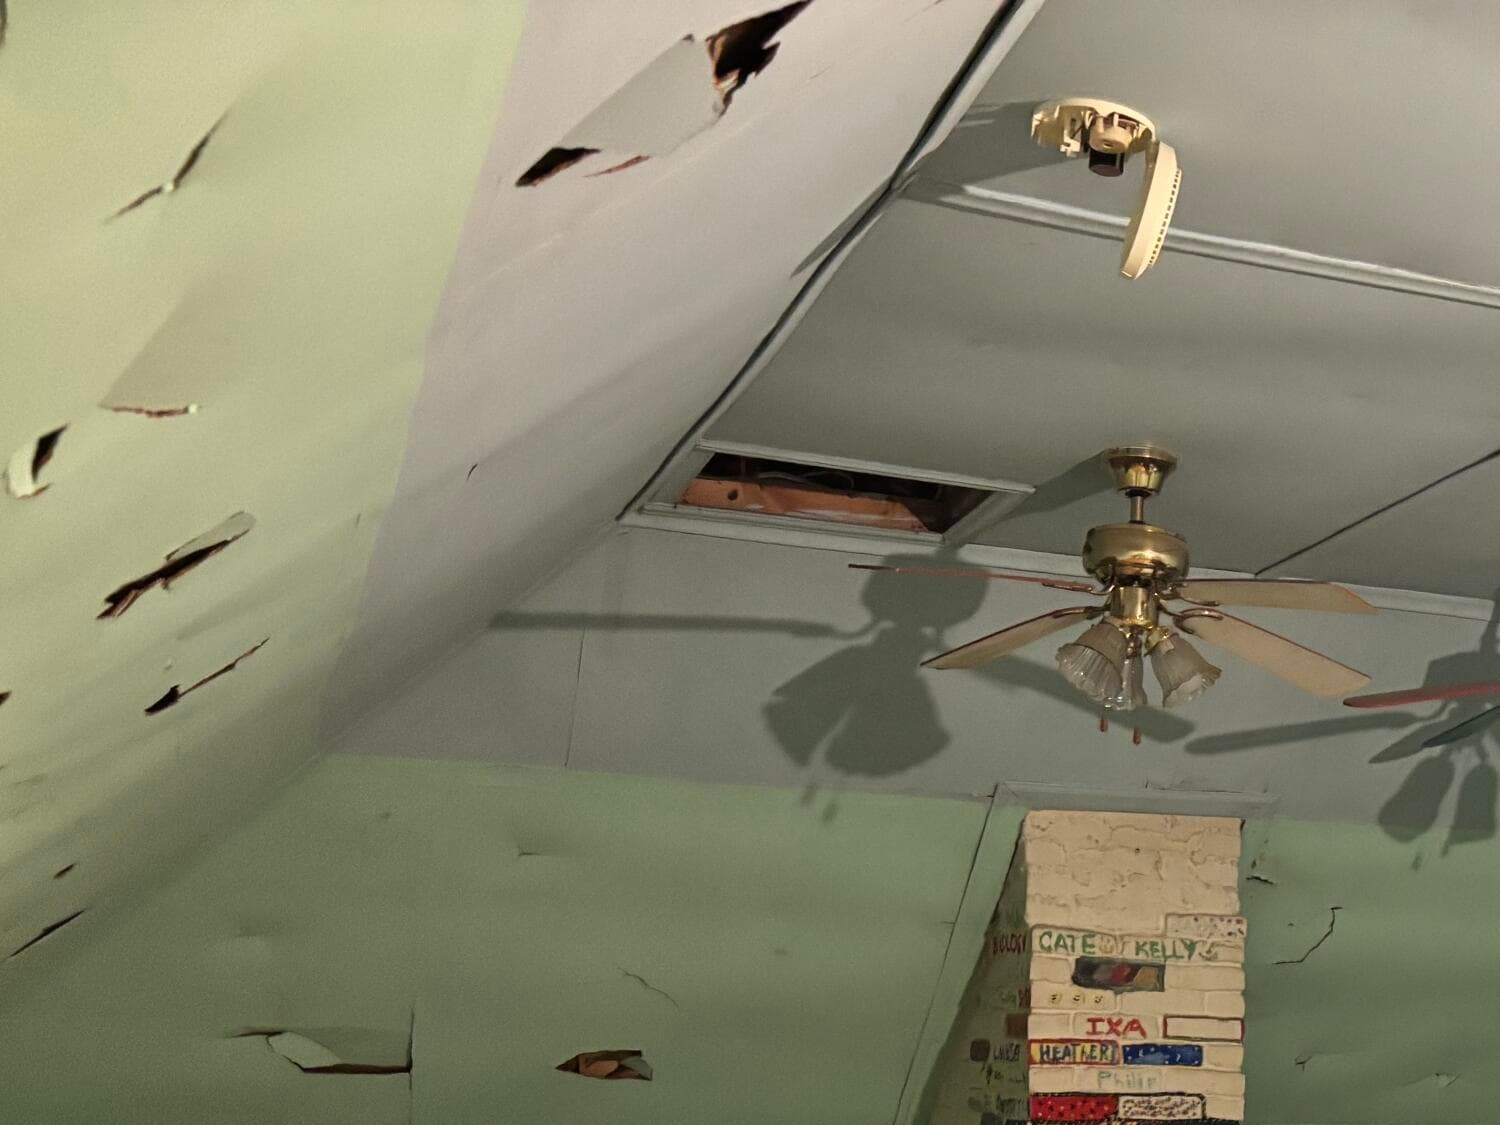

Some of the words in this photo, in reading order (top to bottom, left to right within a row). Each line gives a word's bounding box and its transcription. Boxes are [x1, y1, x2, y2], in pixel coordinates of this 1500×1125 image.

[1039, 930, 1097, 956] CATE
[1135, 937, 1198, 961] KELLY
[1086, 1016, 1148, 1039] IXA
